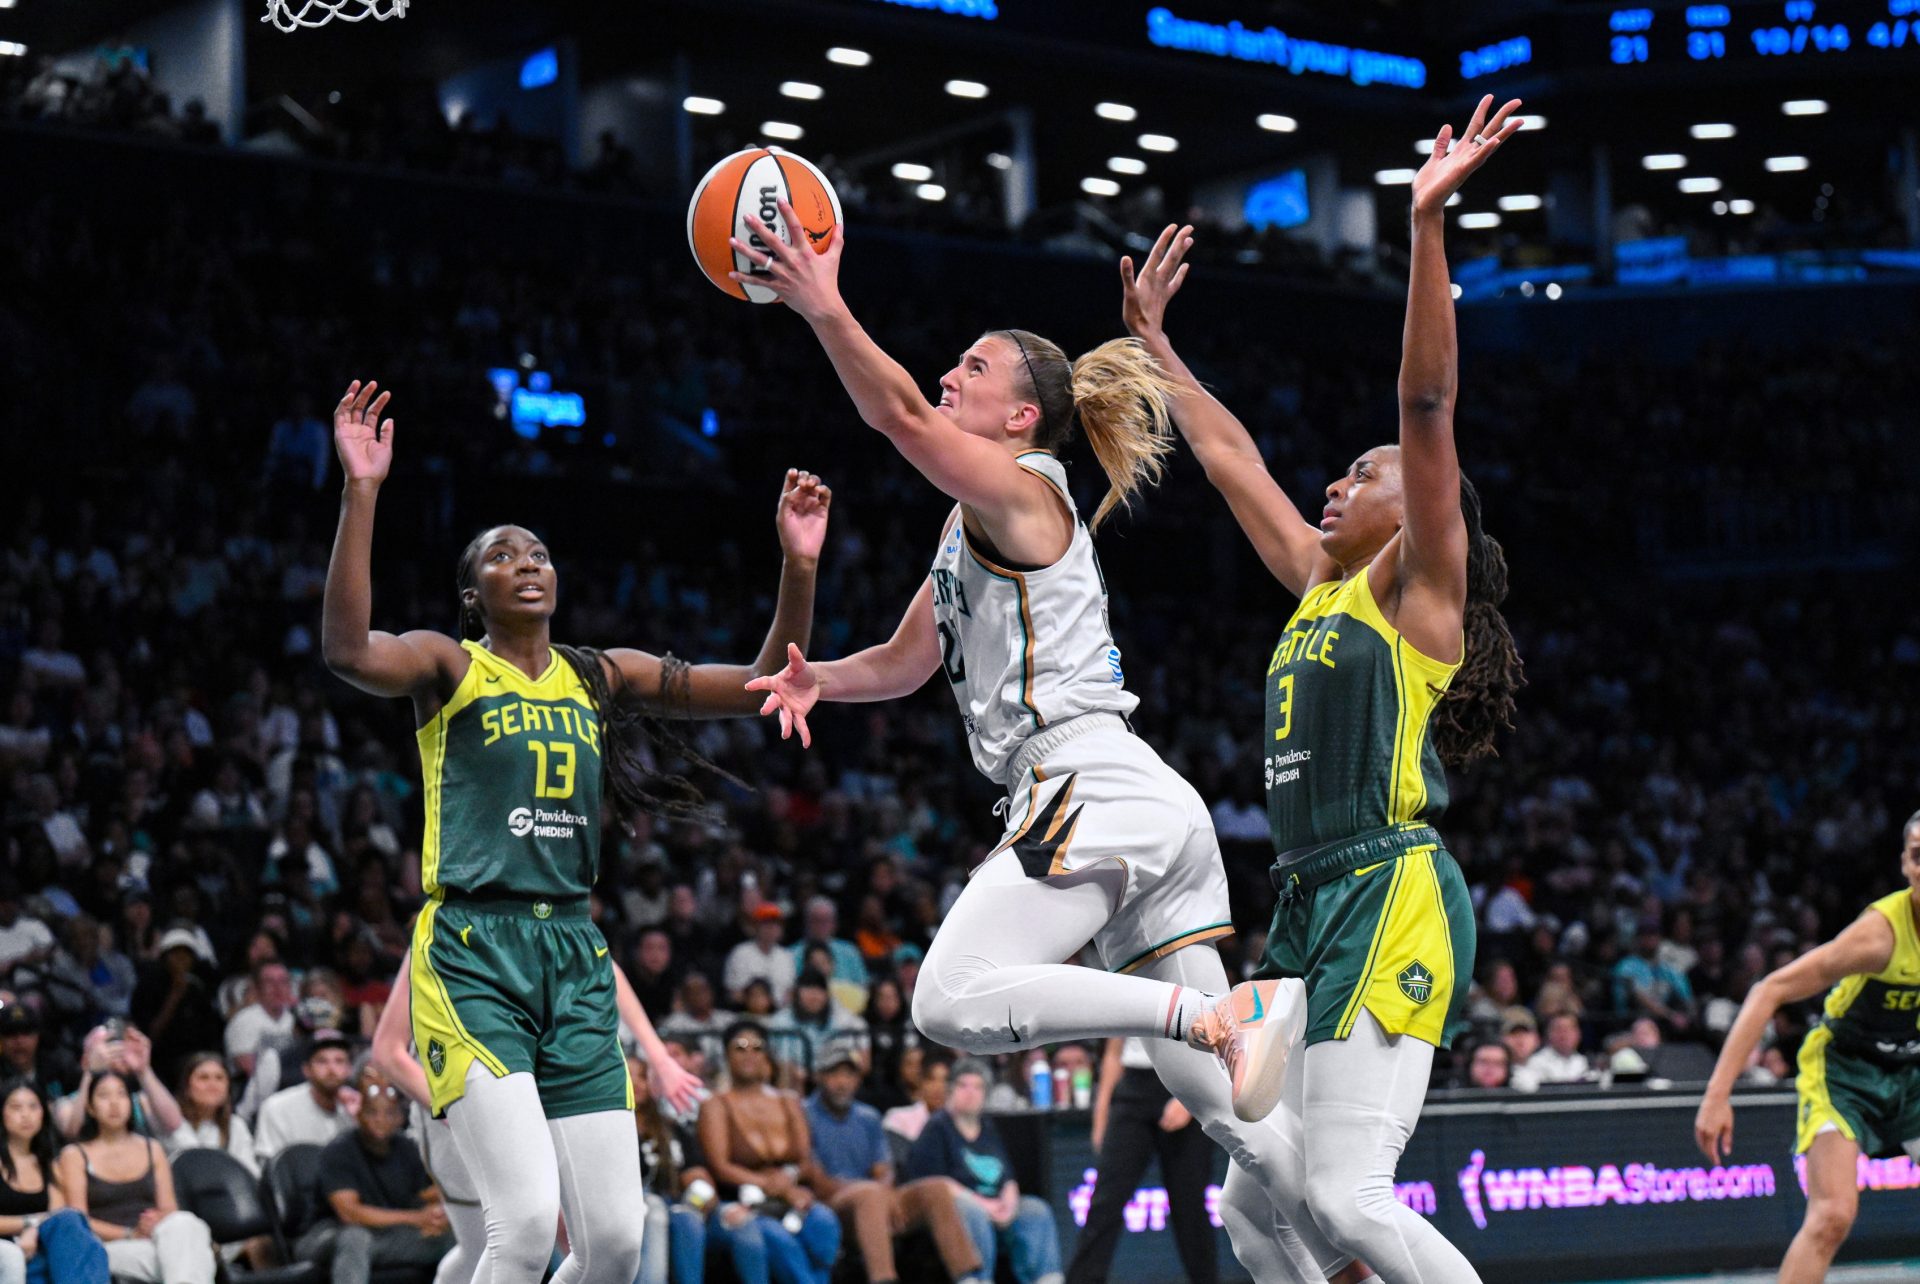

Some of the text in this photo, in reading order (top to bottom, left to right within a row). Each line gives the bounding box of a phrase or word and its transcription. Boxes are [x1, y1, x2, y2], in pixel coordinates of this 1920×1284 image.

[1267, 629, 1340, 677] EATTLE
[481, 700, 600, 757] SEATTLE
[1274, 673, 1295, 741] 3
[527, 739, 577, 800] 13
[1275, 767, 1300, 786] SWEDISH
[533, 825, 574, 839] SWEDISH
